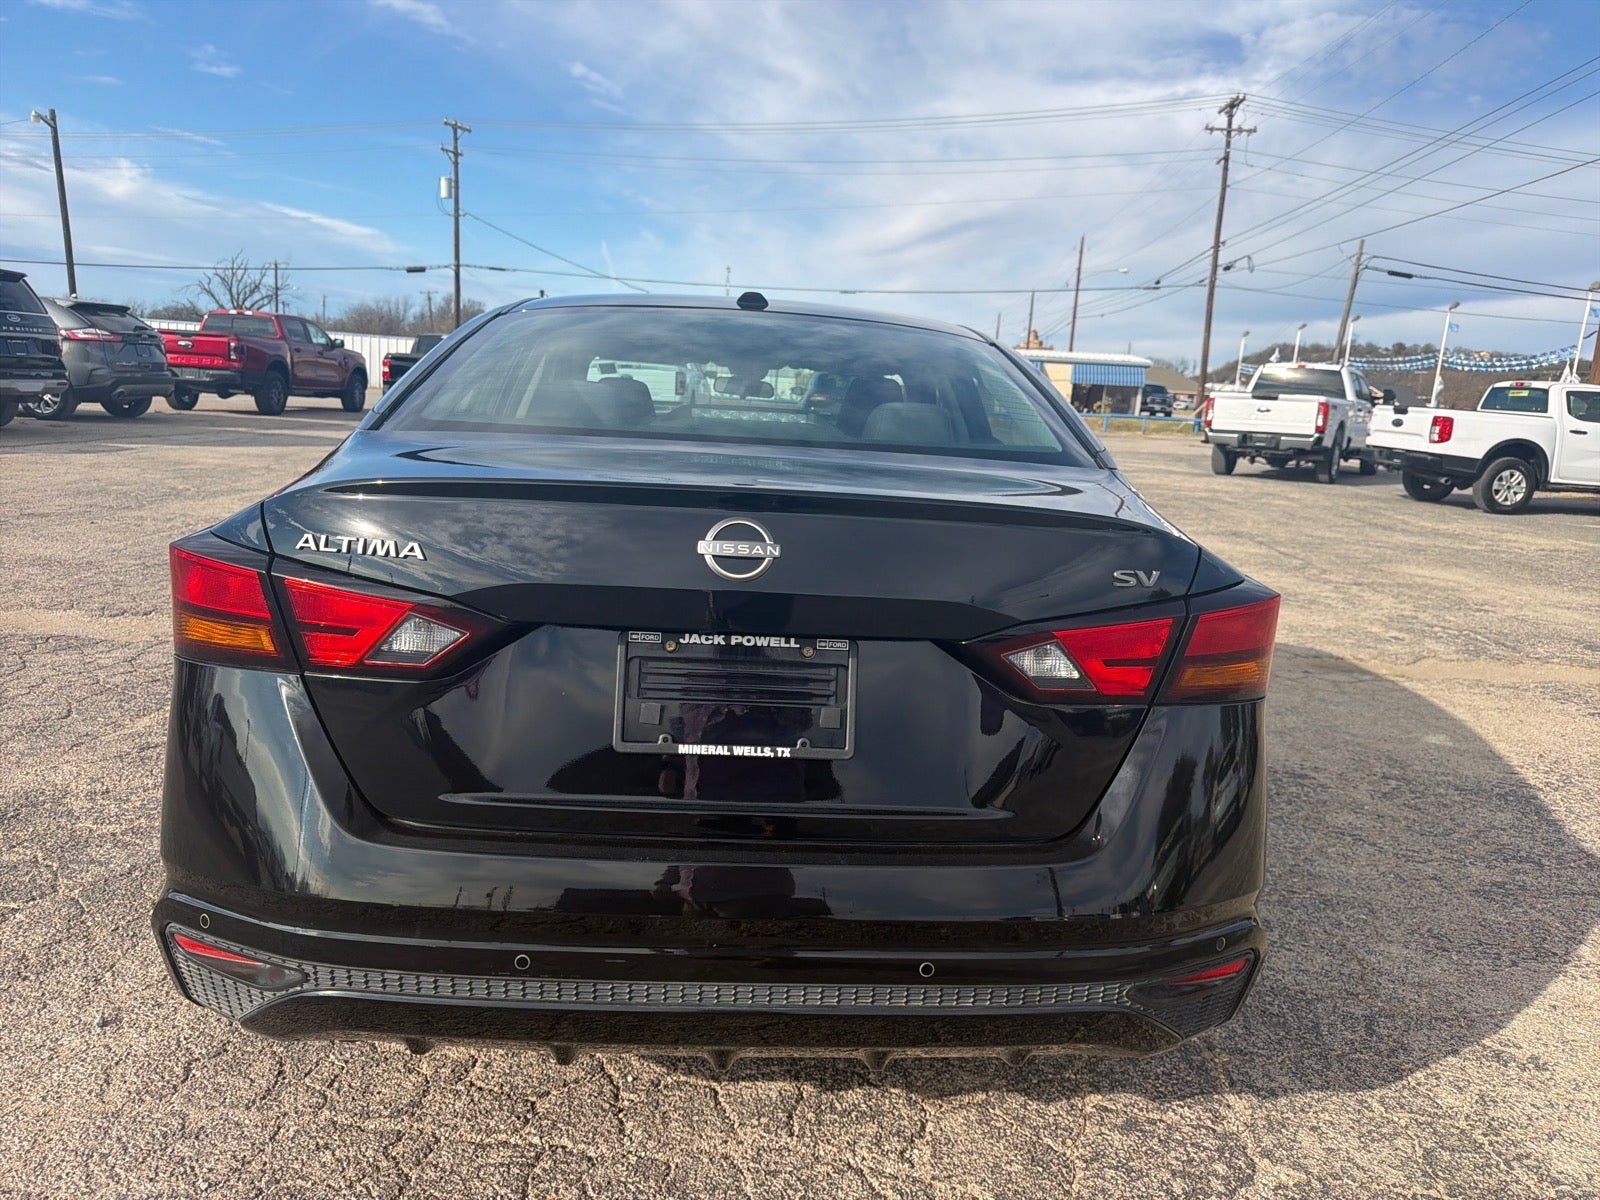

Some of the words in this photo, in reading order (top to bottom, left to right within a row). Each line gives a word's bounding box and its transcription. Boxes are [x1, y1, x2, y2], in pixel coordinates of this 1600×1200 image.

[295, 533, 426, 561] ALTIMA
[700, 543, 780, 556] NISSAN
[1113, 569, 1161, 588] SV
[640, 633, 660, 641] FORD
[679, 633, 726, 645] JACK
[730, 635, 800, 648] POWELL
[678, 744, 731, 755] MINERAL
[733, 746, 774, 757] WELLS,
[776, 747, 791, 758] TX
